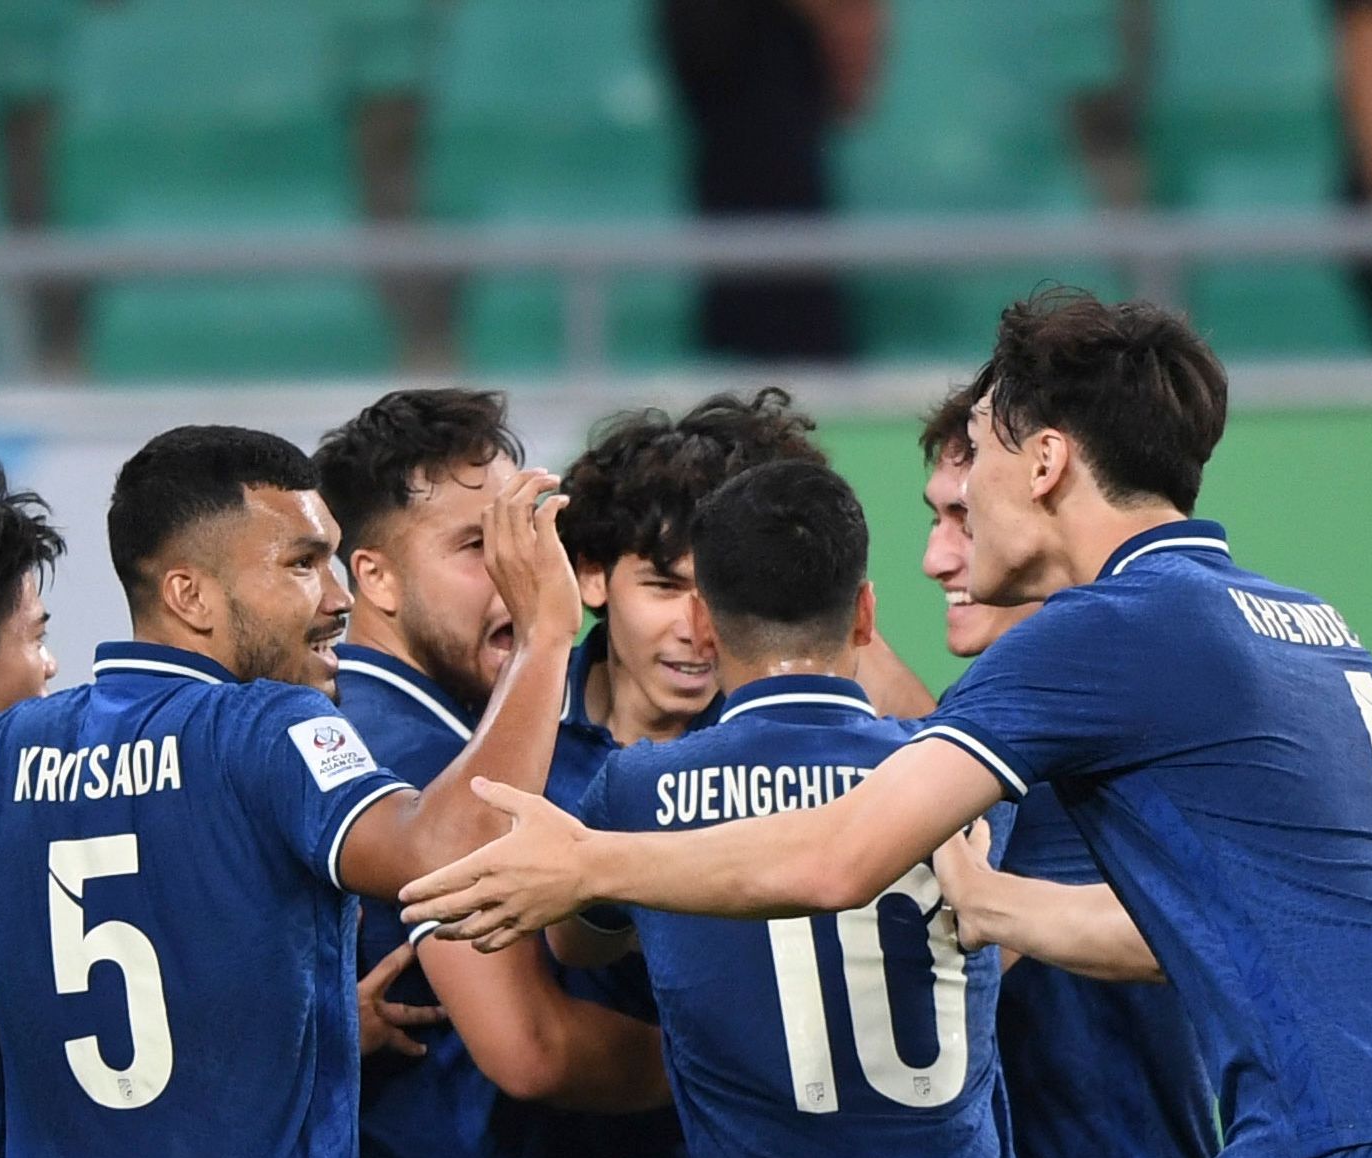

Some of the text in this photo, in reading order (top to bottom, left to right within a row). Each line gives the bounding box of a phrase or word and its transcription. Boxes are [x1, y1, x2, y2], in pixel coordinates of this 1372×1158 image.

[14, 735, 181, 802] KRITSADA
[48, 833, 174, 1110] 5
[767, 863, 969, 1114] 10
